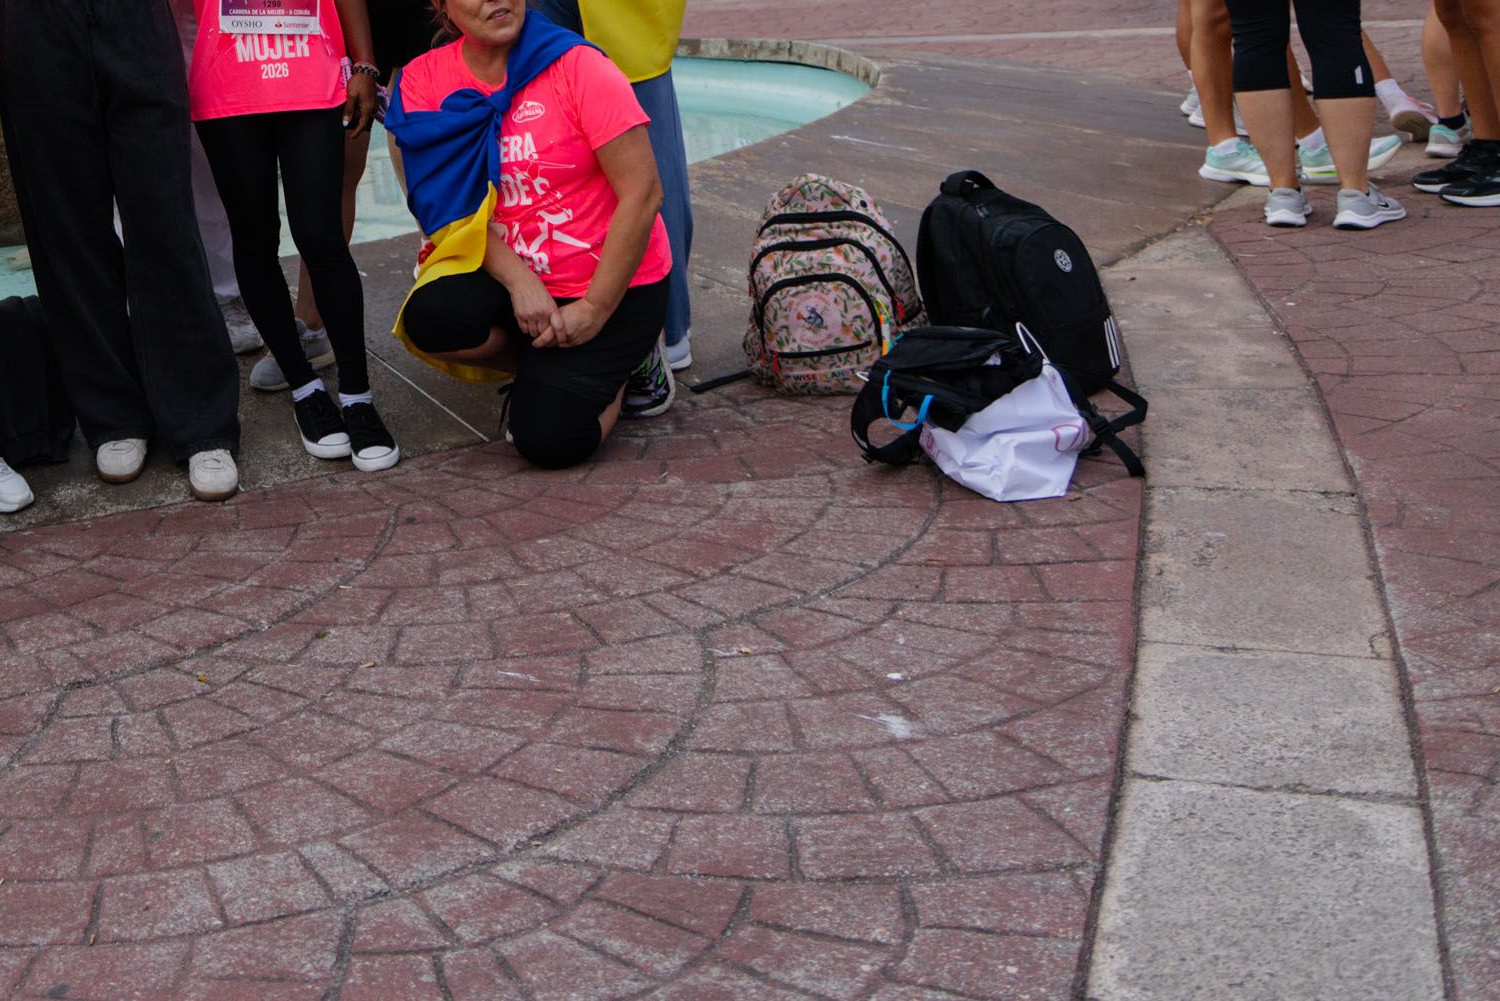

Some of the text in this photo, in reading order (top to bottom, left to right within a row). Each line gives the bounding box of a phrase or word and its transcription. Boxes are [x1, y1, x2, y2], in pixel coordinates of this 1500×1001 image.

[231, 20, 263, 28] OYSHO
[235, 34, 310, 62] MUJER
[261, 63, 289, 79] 2026
